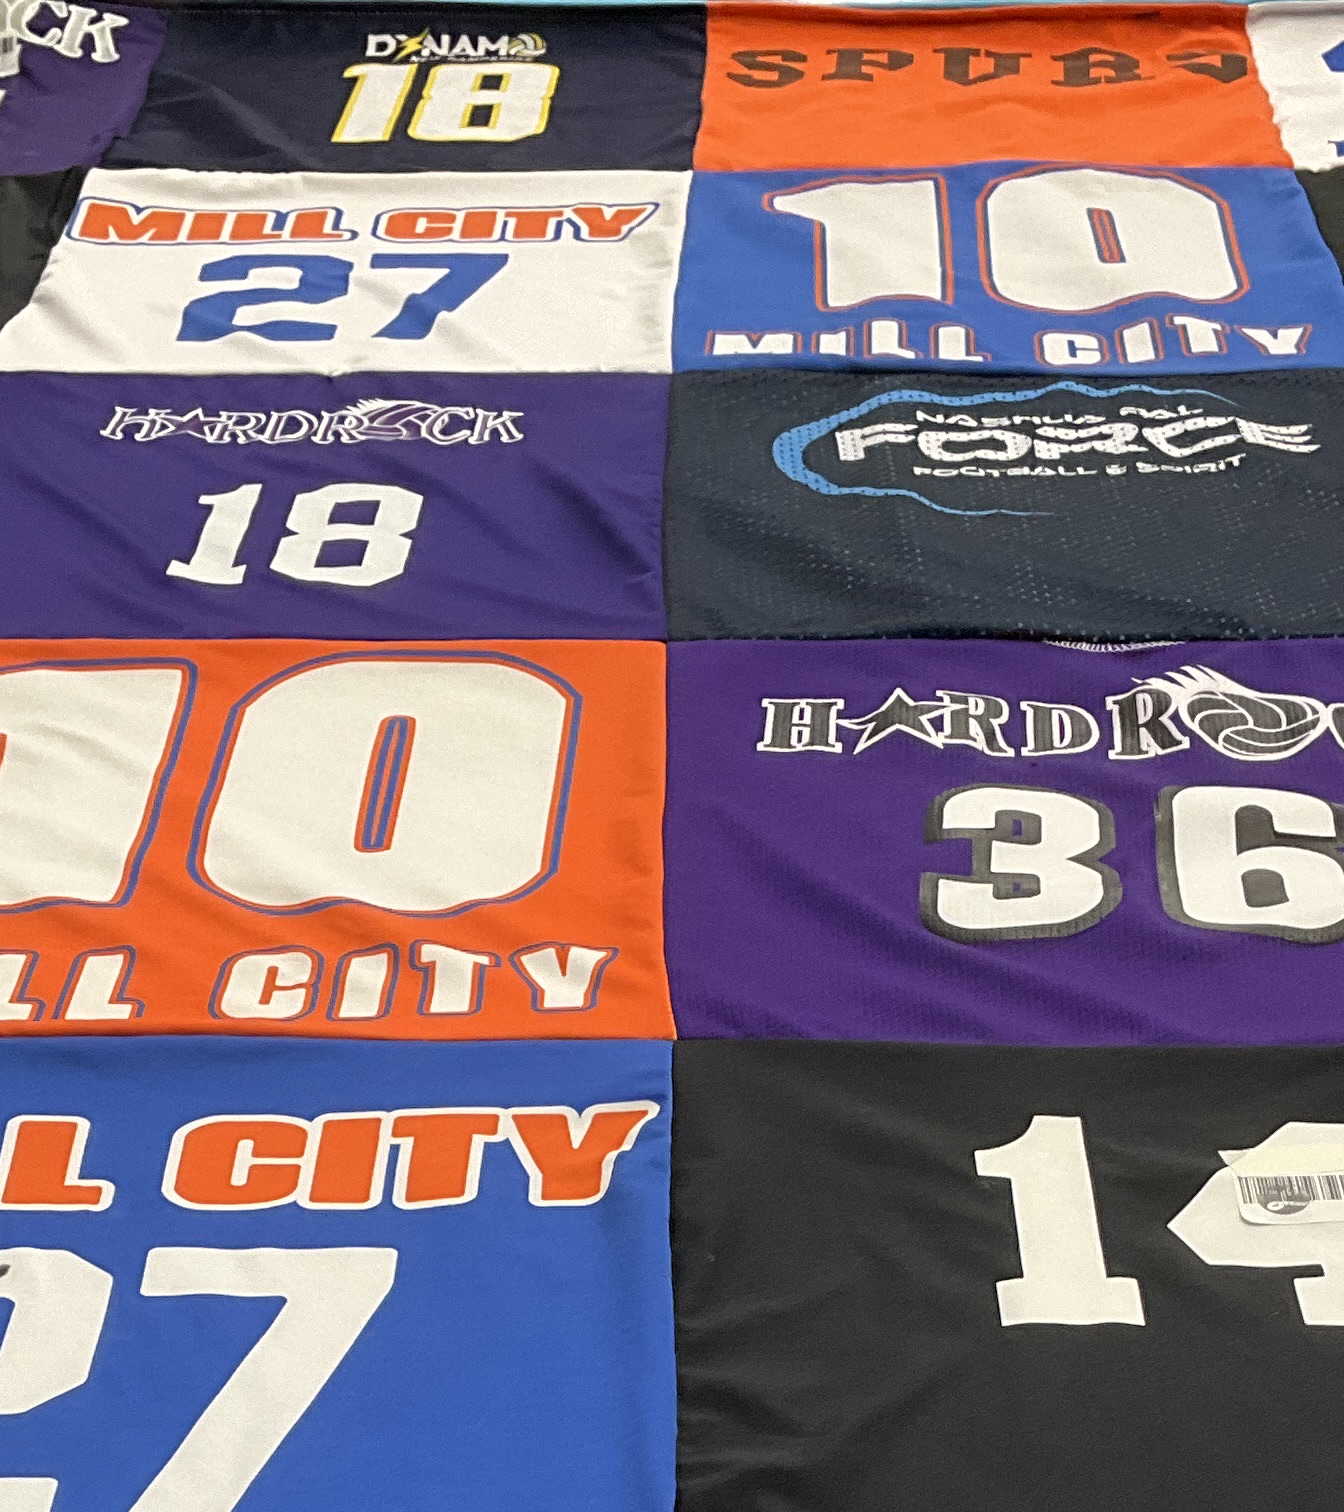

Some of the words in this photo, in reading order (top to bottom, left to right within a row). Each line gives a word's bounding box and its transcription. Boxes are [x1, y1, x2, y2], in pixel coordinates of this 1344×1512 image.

[330, 62, 560, 143] 18
[64, 197, 360, 245] MILL
[371, 202, 660, 244] CITY
[763, 162, 1250, 313] 10
[175, 253, 510, 342] 27
[706, 318, 991, 362] MILL
[1036, 314, 1312, 366] CITY
[834, 415, 1321, 462] FORCE
[912, 463, 1098, 478] FOOTBALL
[165, 482, 424, 588] 18
[210, 941, 620, 1022] CITY
[160, 1100, 660, 1211] CITY
